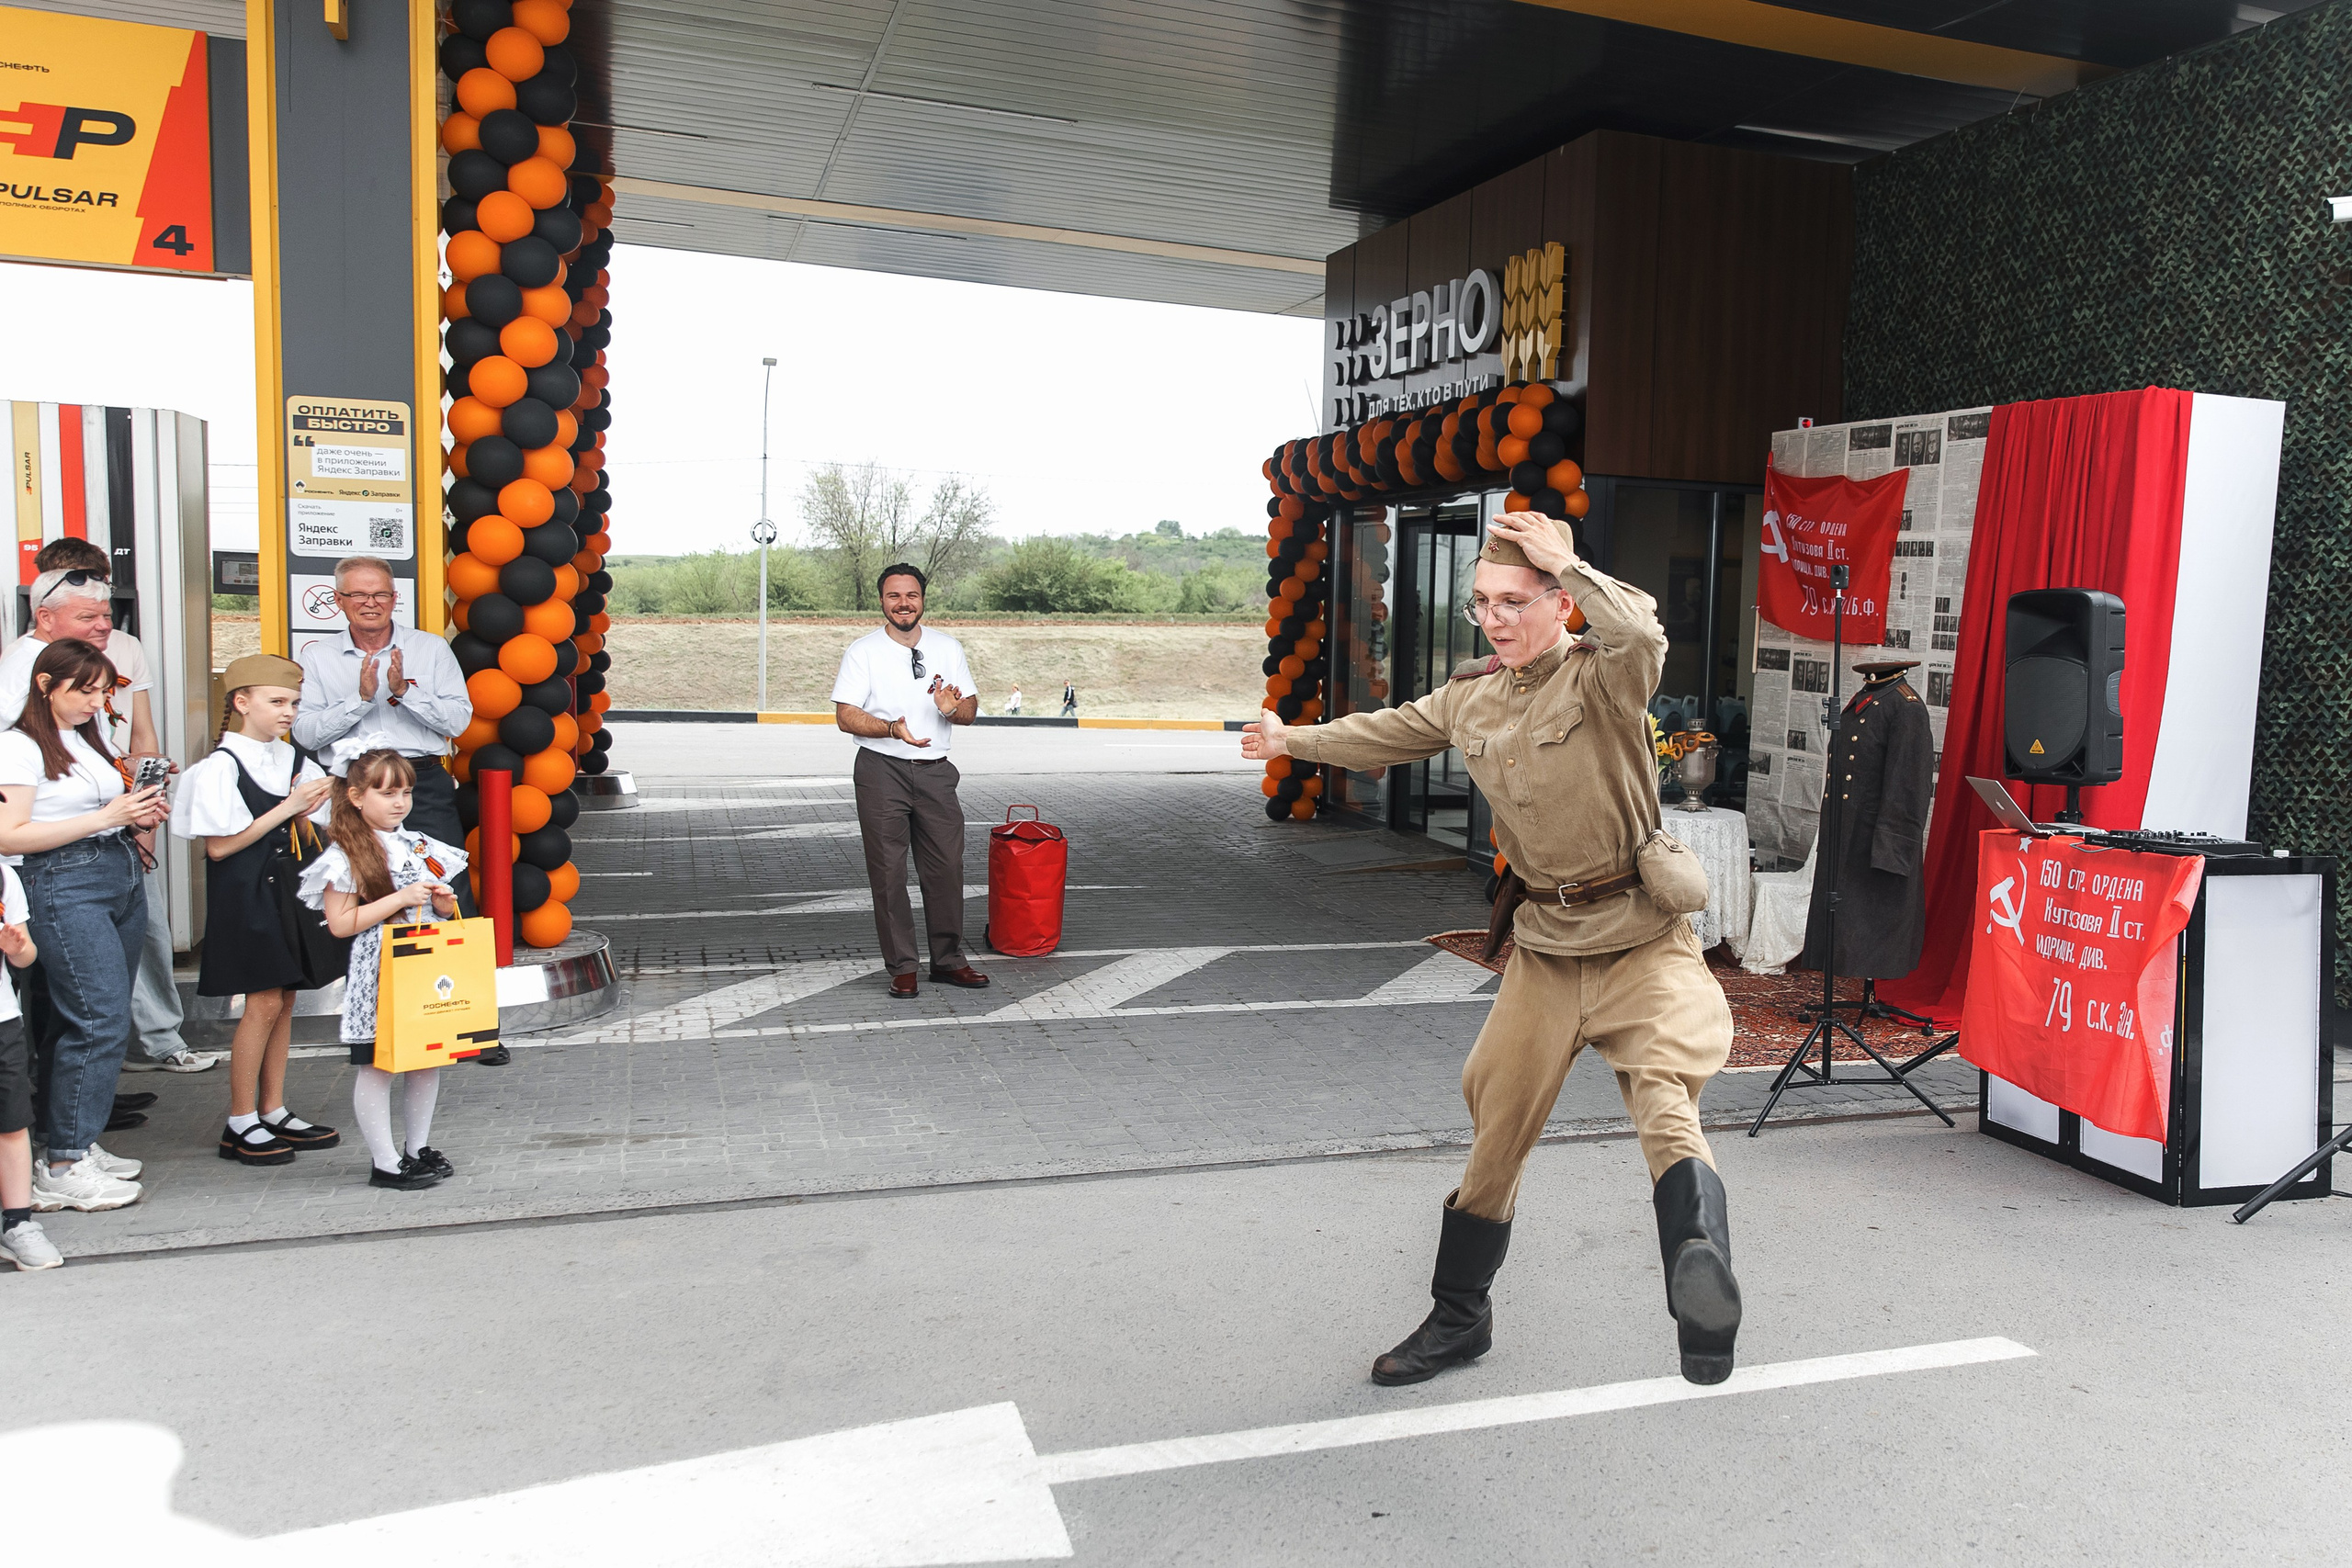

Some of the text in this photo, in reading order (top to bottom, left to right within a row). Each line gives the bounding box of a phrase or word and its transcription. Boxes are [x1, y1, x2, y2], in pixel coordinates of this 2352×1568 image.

[39, 205, 86, 213] ОБОРОТАХ
[153, 224, 195, 256] 4
[1370, 268, 1499, 379] ЗЕРНО
[1367, 373, 1490, 422] ДЛЯ ТЕХ, КТО В ПУТИ
[298, 405, 399, 420] ОПЛАТИТЬ
[307, 418, 390, 433] БЫСТРО
[24, 451, 32, 489] PULSAR
[324, 458, 387, 467] приложении
[317, 465, 401, 477] Яндекс Заправки
[370, 491, 401, 499] Заправки
[299, 523, 338, 534] Яндекс
[1820, 521, 1848, 536] ОРДЕНА
[299, 536, 354, 547] Заправки
[114, 547, 131, 556] ДТ
[1801, 584, 1818, 615] 79
[2040, 859, 2144, 902] 150 СТР. ОРДЕНА
[2078, 945, 2108, 970] ДИВ.
[423, 999, 470, 1010] РОСНЕФТЬ
[2045, 977, 2073, 1032] 79
[2086, 999, 2113, 1032] С.К.
